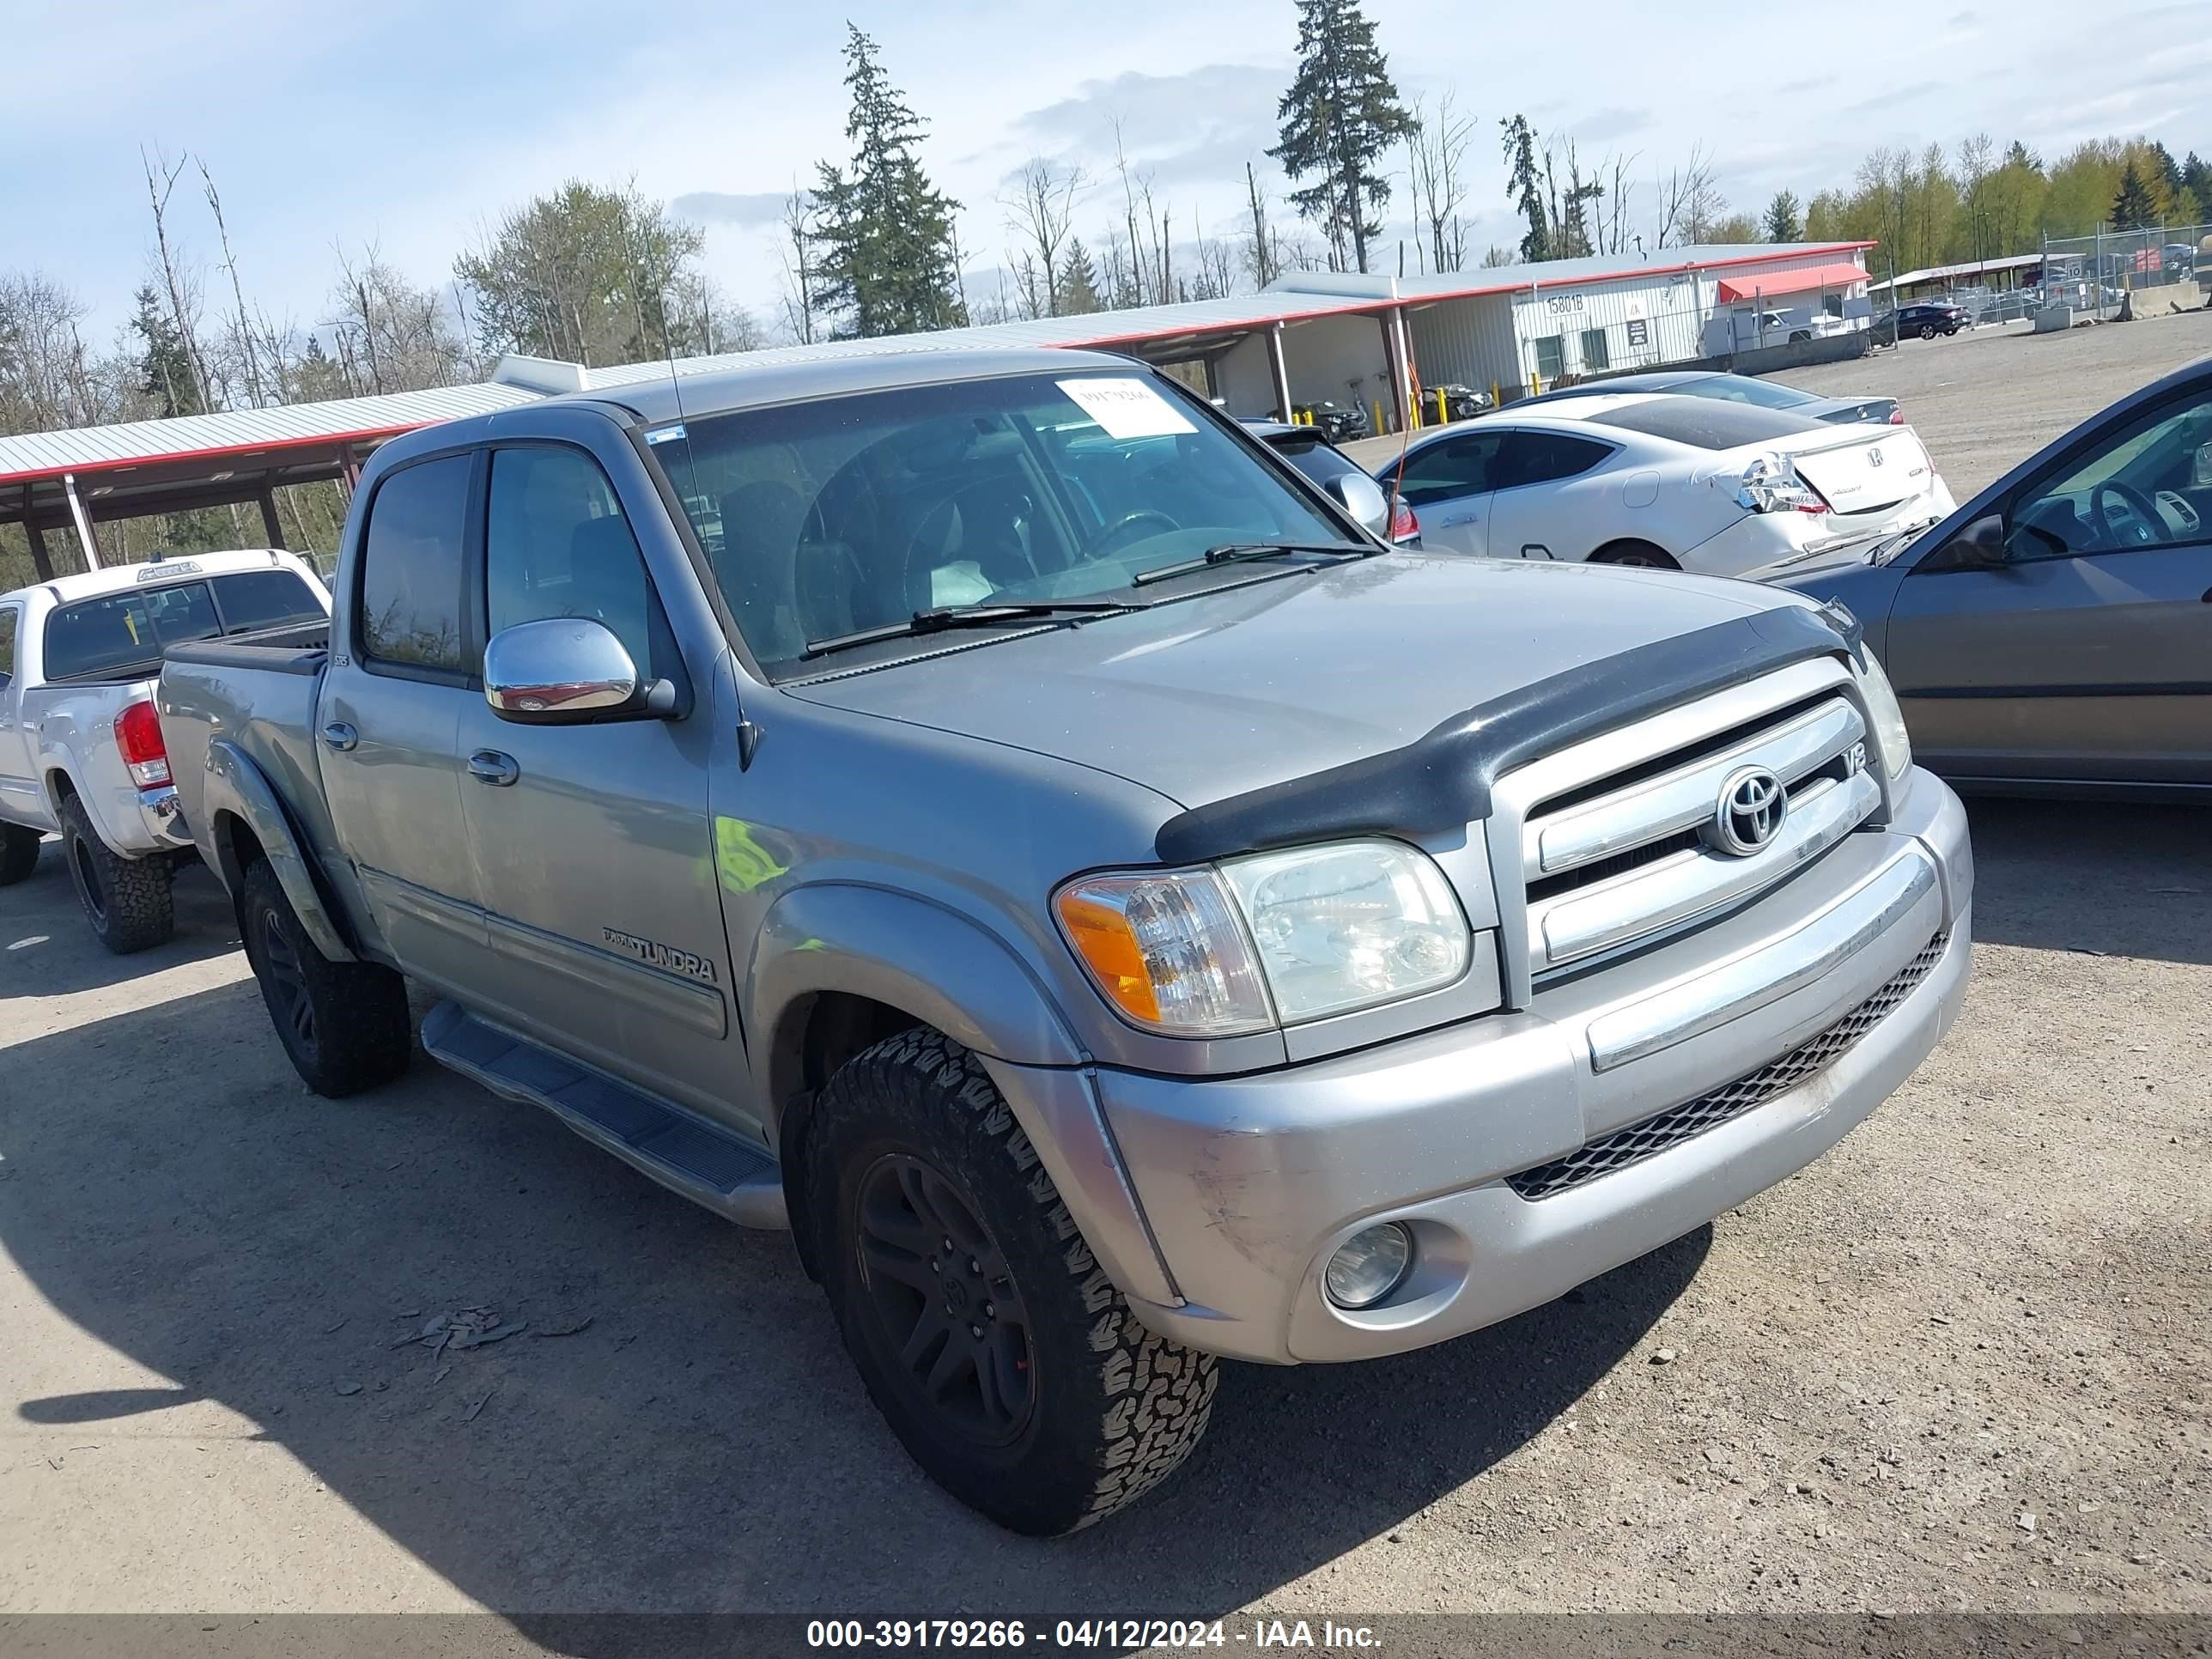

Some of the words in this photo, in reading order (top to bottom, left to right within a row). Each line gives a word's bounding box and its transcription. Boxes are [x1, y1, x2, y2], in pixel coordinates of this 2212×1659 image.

[2069, 267, 2081, 277] 10
[1547, 295, 1583, 314] 15801B
[1840, 742, 1866, 778] V8
[602, 927, 636, 950] TOYOTA
[632, 937, 718, 981] TUNDRA
